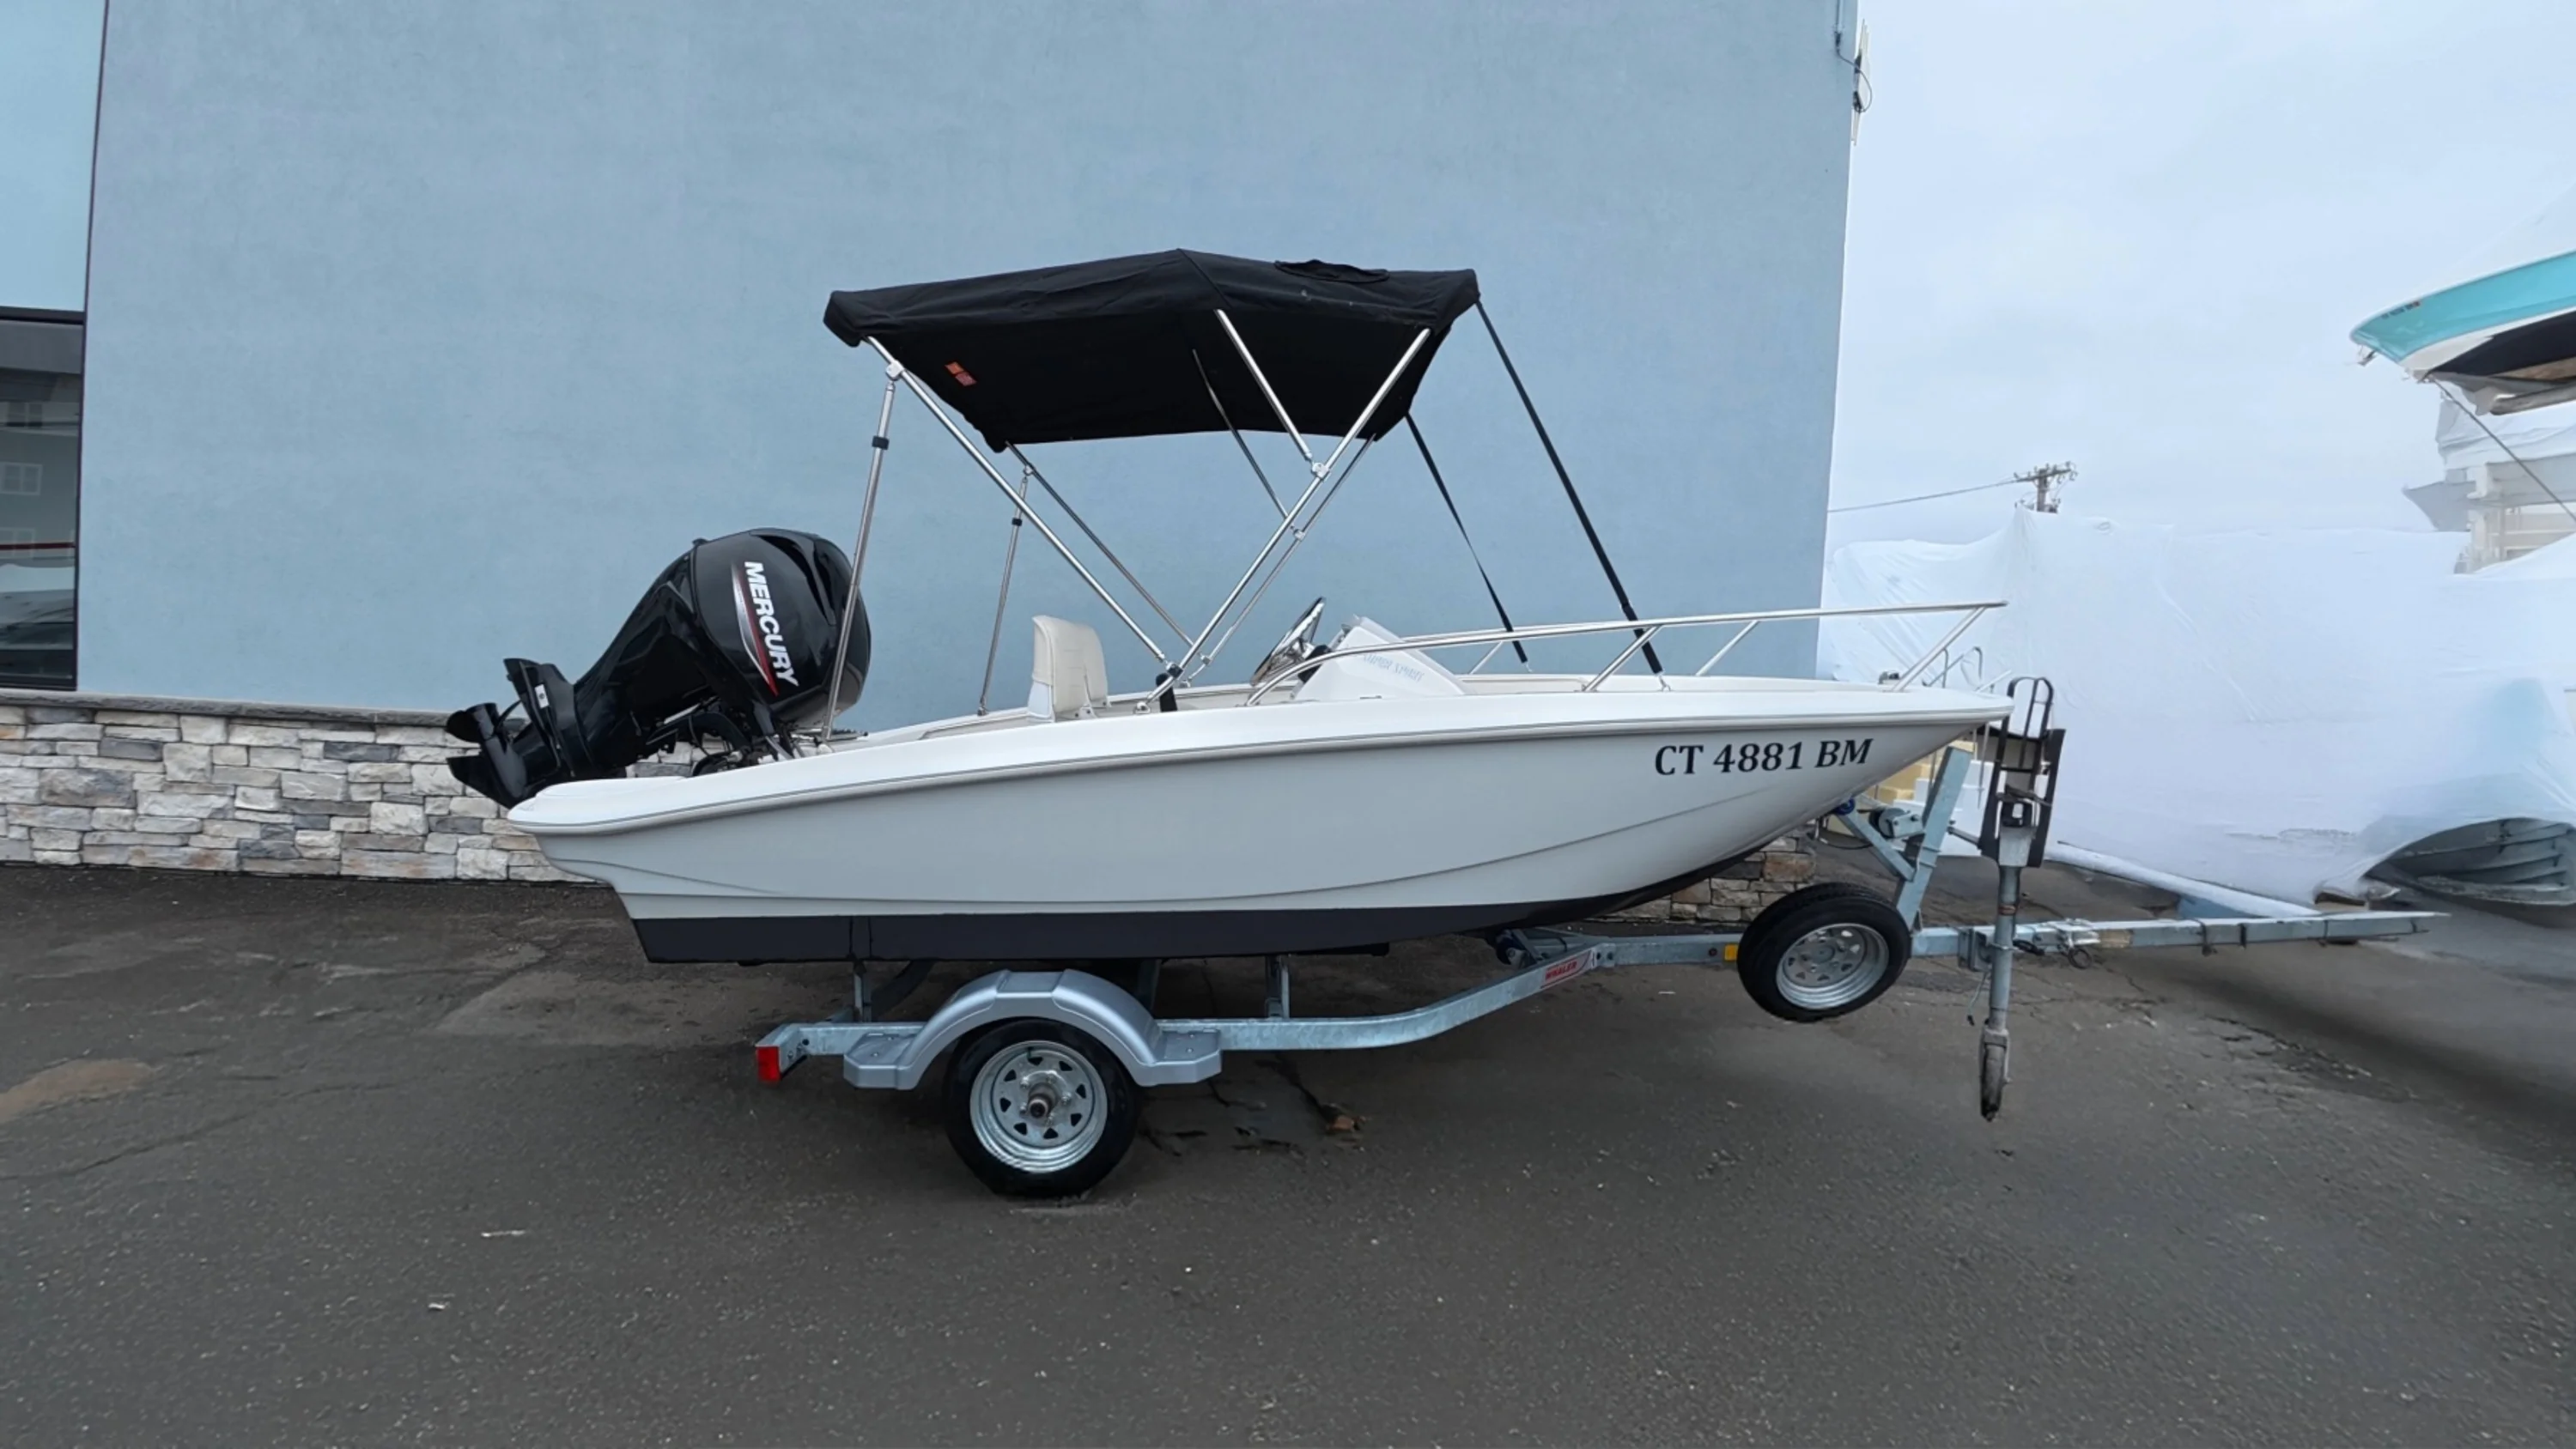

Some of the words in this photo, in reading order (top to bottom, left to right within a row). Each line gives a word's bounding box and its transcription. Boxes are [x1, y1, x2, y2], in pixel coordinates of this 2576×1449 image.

[744, 561, 799, 687] MERCURY
[1655, 744, 1704, 775] CT
[1713, 742, 1803, 773] 4881
[1814, 738, 1874, 768] BM
